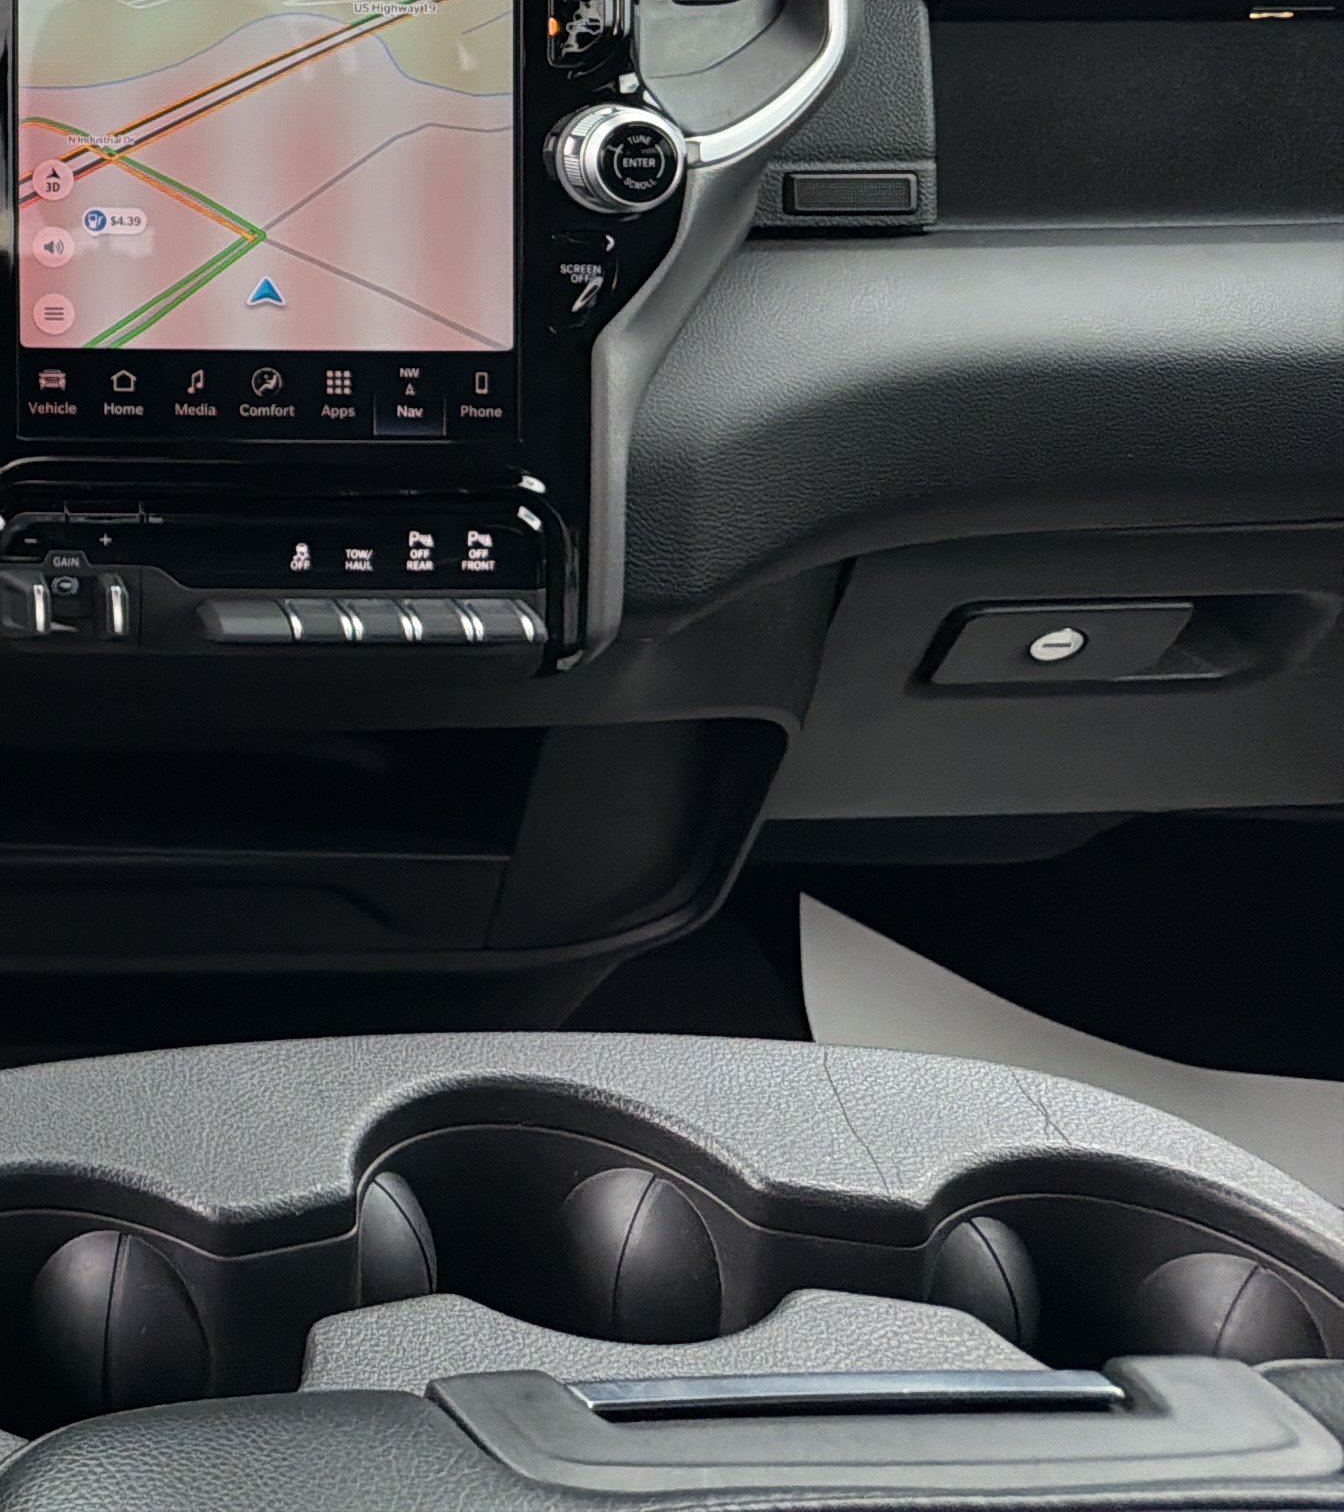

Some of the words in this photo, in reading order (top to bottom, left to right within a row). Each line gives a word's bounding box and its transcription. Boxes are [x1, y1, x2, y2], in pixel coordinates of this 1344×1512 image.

[354, 3, 369, 13] US
[372, 2, 419, 15] Highway
[627, 135, 653, 145] TUNE
[622, 157, 656, 168] ENTER
[45, 181, 61, 193] 3D
[623, 176, 658, 190] SCROLL
[110, 215, 142, 227] $4.39
[559, 263, 602, 275] SCREEN
[399, 367, 420, 378] NW
[28, 401, 78, 415] Vehicle
[103, 402, 145, 416] Home
[174, 402, 218, 416] Media
[239, 403, 296, 418] Comfort
[321, 404, 357, 420] Apps
[396, 404, 425, 419] Nav
[459, 404, 504, 419] Phone
[345, 549, 374, 561] TOW/
[409, 549, 430, 560] OFF
[468, 549, 489, 560] OFF
[52, 556, 80, 568] GAIN
[289, 560, 311, 571] OFF
[345, 560, 374, 571] HAUL
[406, 560, 434, 571] REAR
[461, 560, 496, 571] FRONT
